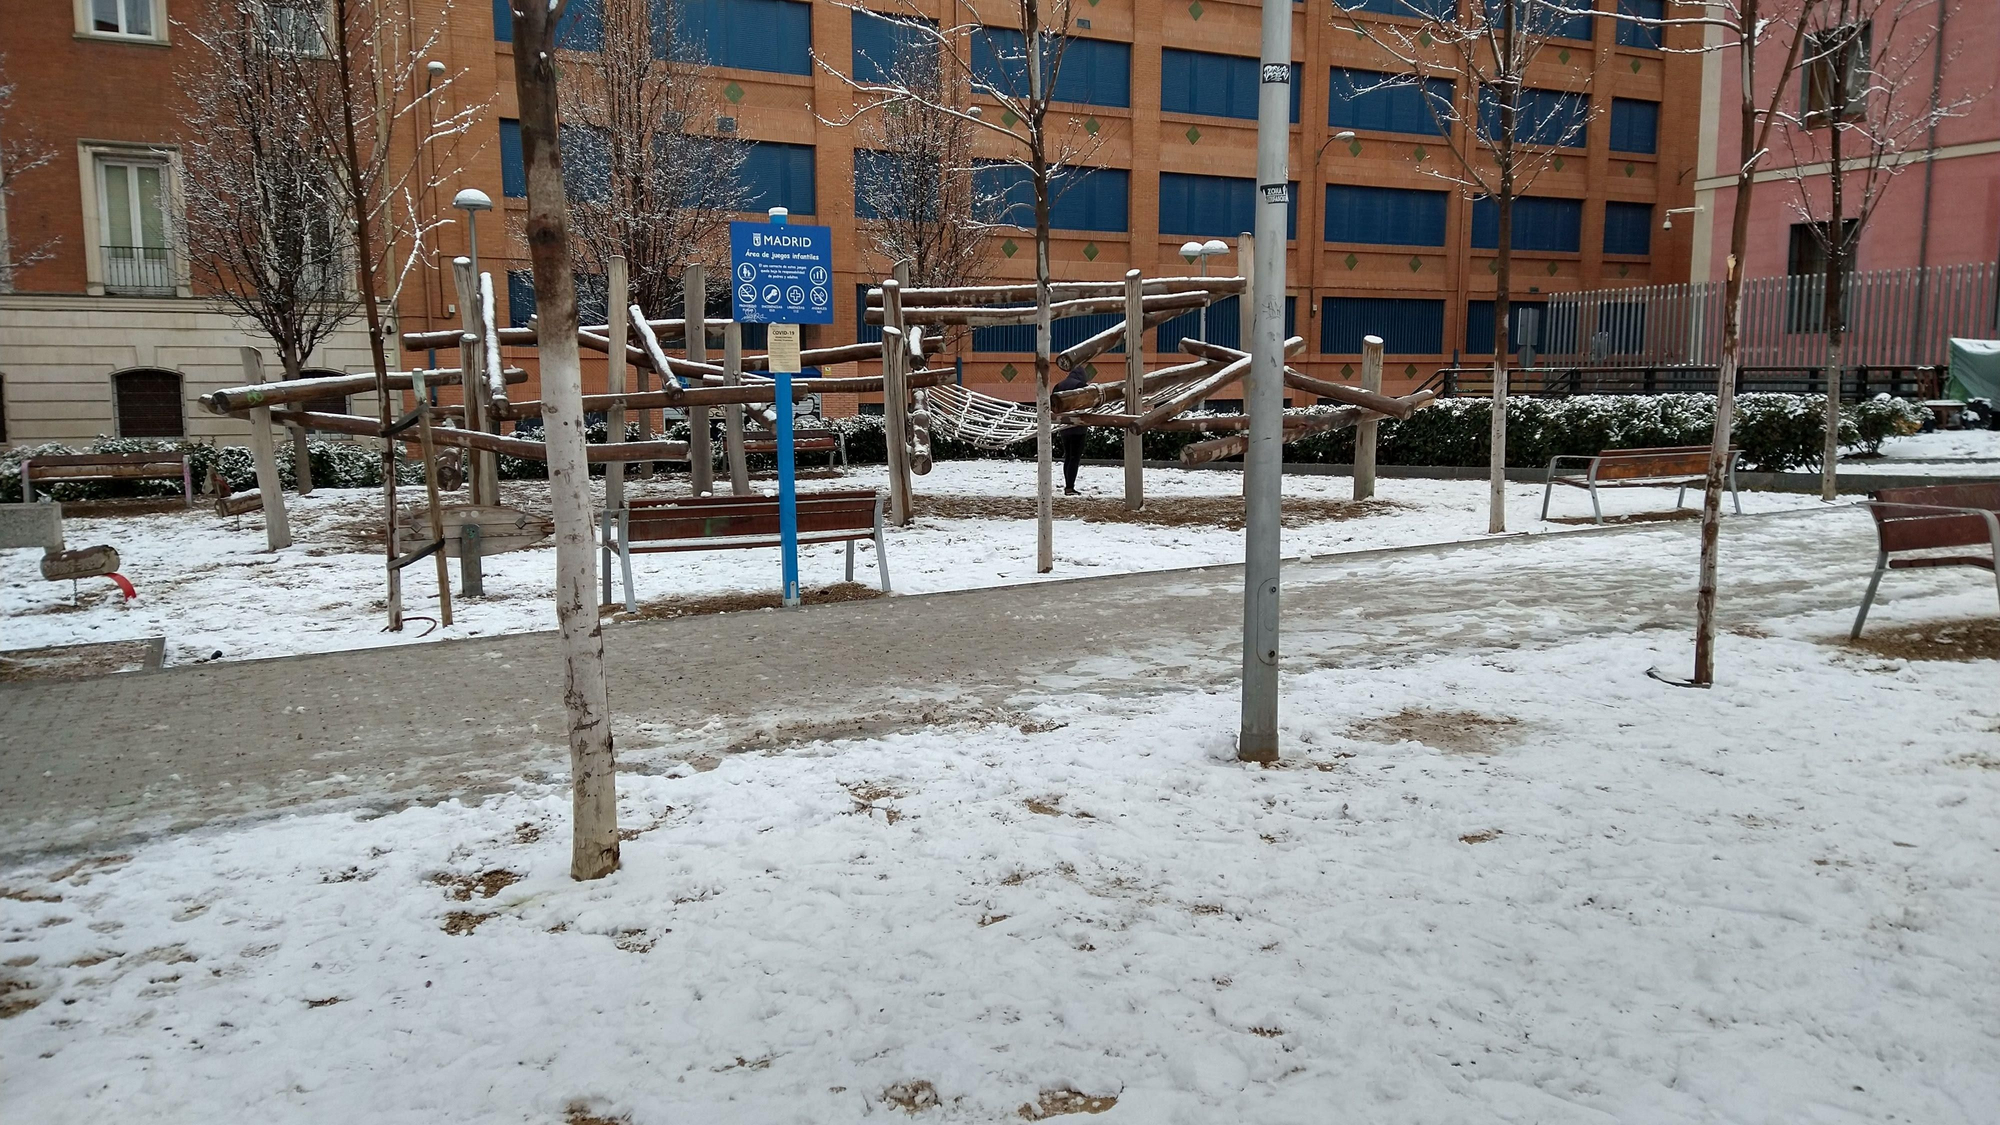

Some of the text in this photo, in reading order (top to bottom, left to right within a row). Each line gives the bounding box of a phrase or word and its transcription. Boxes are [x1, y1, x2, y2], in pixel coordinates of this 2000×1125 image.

[763, 235, 812, 247] MADRID
[745, 249, 760, 257] Área
[771, 252, 790, 260] juegos
[792, 252, 819, 260] infantiles
